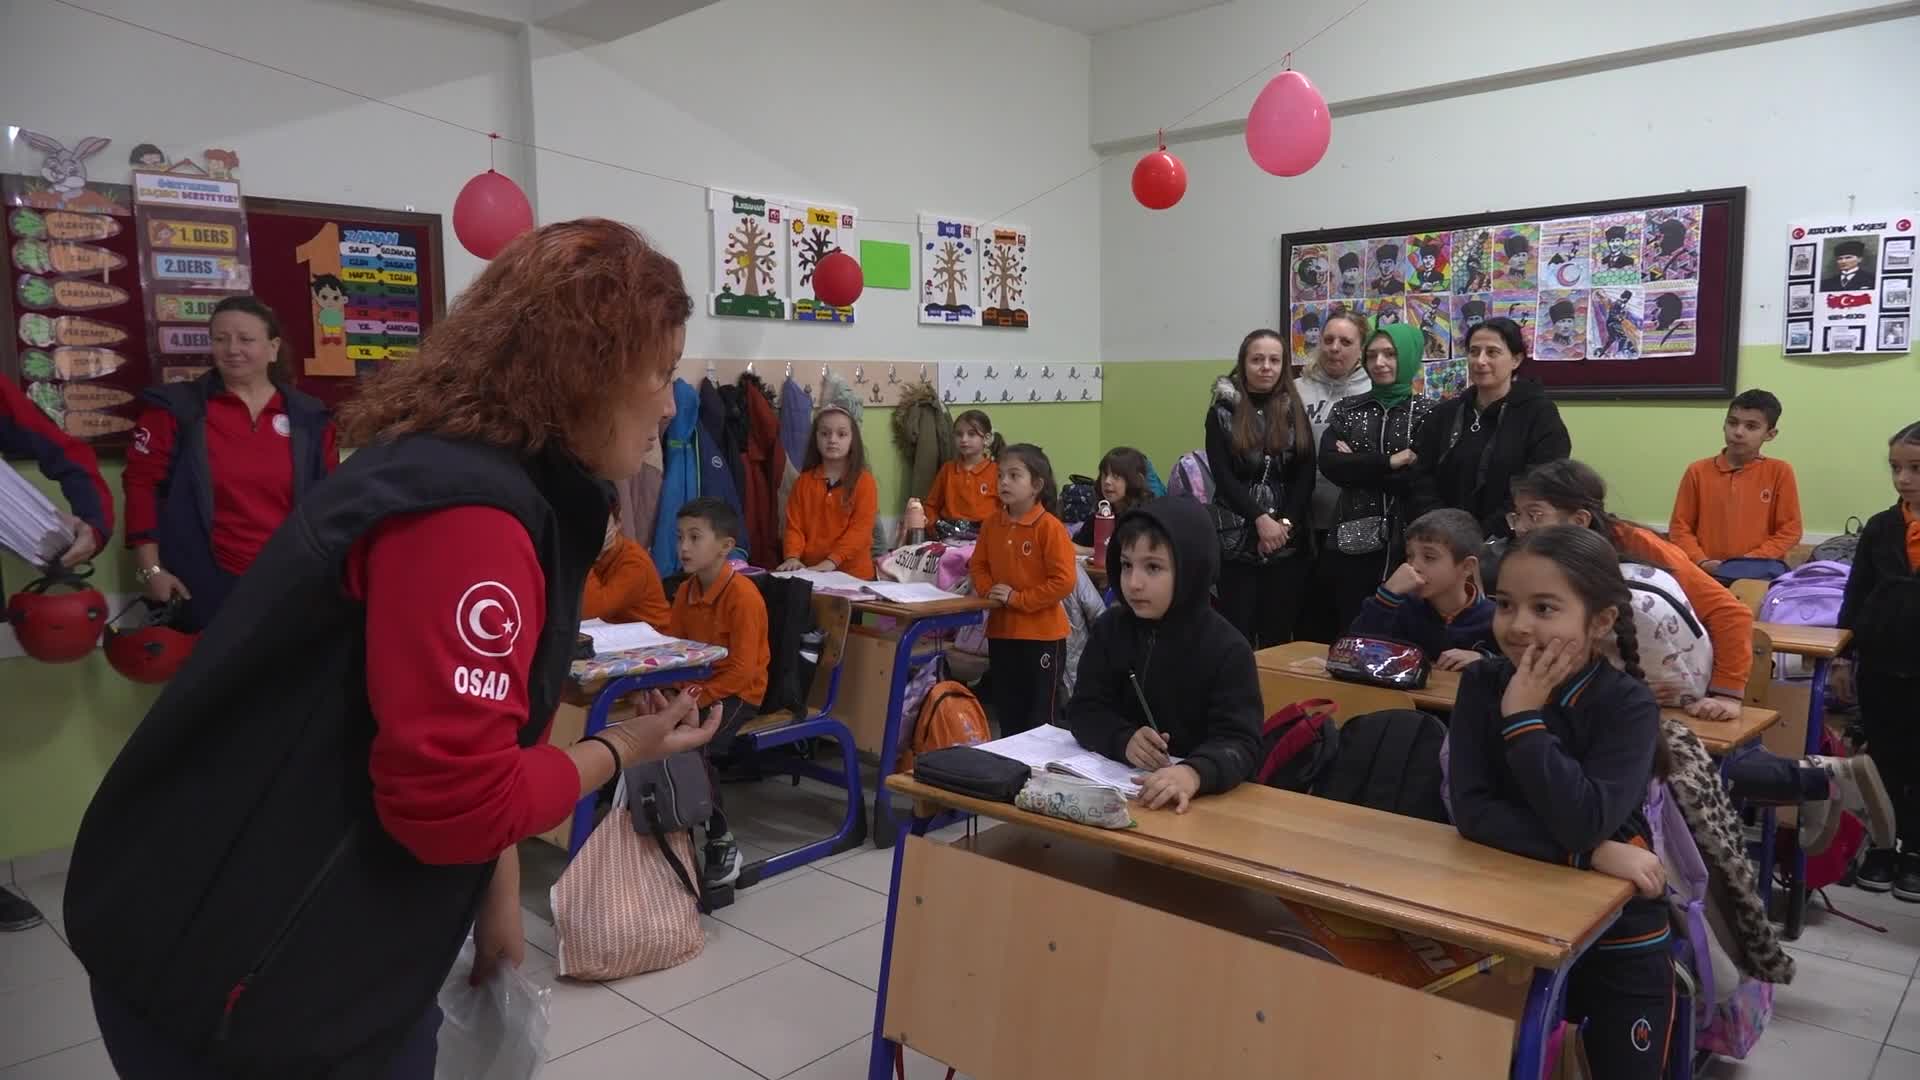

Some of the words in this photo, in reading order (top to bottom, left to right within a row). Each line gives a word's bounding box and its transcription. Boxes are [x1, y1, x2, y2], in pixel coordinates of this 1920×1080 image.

[815, 213, 830, 224] YAZ
[193, 228, 229, 244] DERS
[348, 246, 370, 255] SAAT
[348, 272, 376, 280] HAFTA
[184, 301, 216, 315] 3.DE
[170, 332, 213, 347] 4.DER
[454, 665, 511, 701] OSAD
